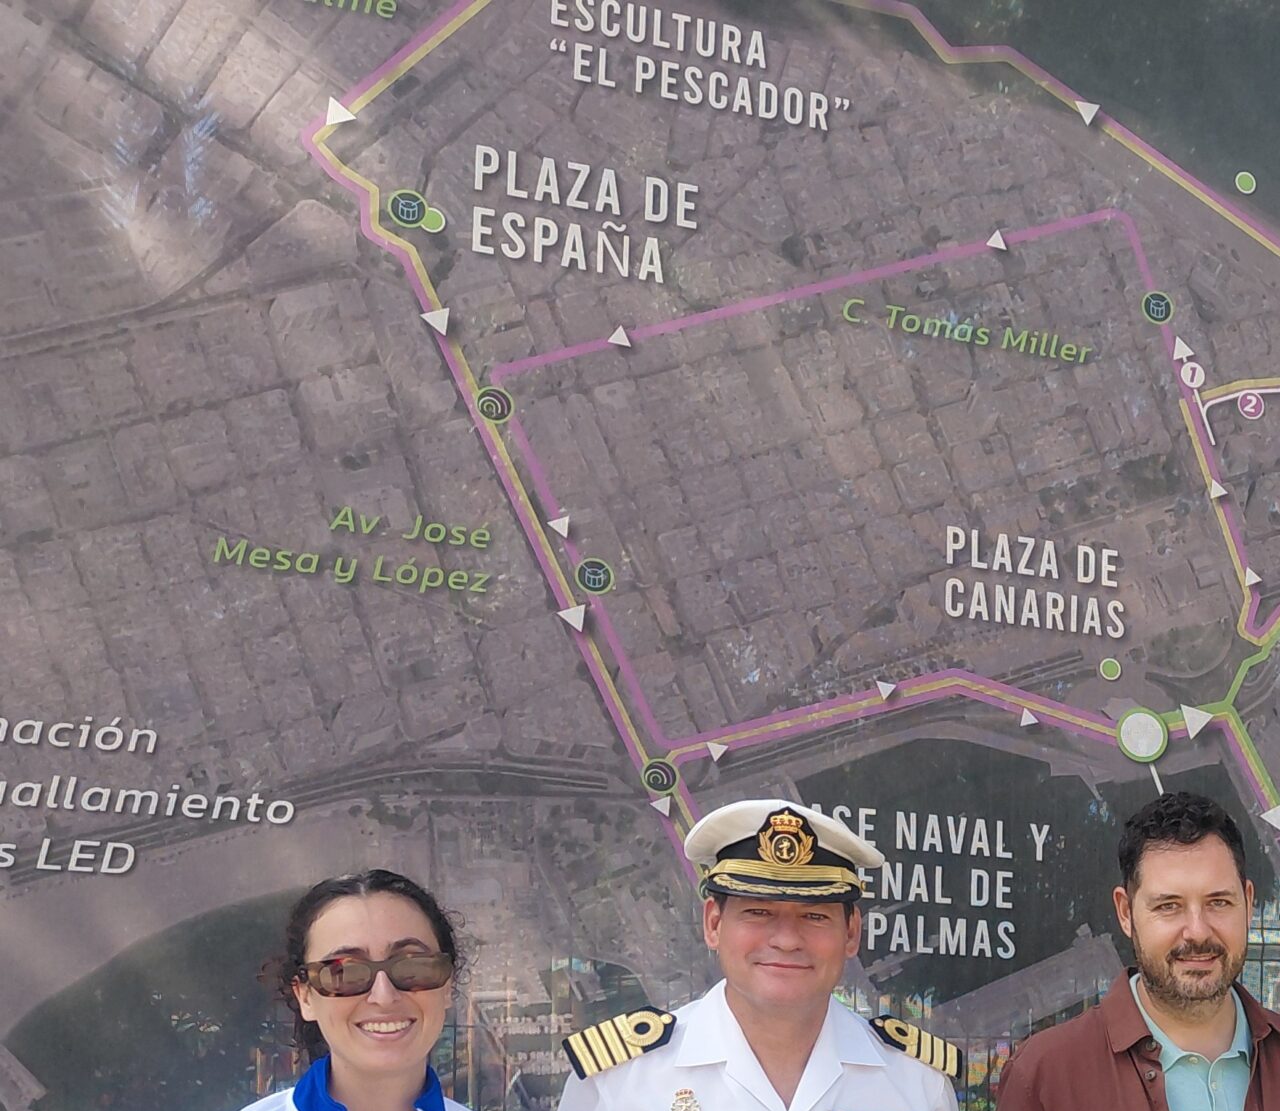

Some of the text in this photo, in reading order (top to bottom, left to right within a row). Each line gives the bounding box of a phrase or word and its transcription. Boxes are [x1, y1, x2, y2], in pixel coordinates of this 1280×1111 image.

[550, 0, 767, 69] ESCULTURA
[474, 144, 698, 230] PLAZA DE
[471, 206, 664, 284] ESPAÑA
[841, 299, 1093, 363] C. Tomás Miller
[1189, 367, 1197, 383] 1
[1243, 395, 1257, 413] 2
[402, 515, 492, 548] José
[213, 537, 492, 593] Mesa y López
[946, 526, 1118, 588] PLAZA DE
[944, 578, 1125, 639] CANARIAS
[0, 775, 296, 825] allamiento
[36, 838, 136, 874] LED
[895, 811, 1013, 859] NAVAL
[1029, 823, 1051, 861] Y
[858, 861, 1013, 909] ENAL DE
[867, 912, 1016, 960] PALMAS
